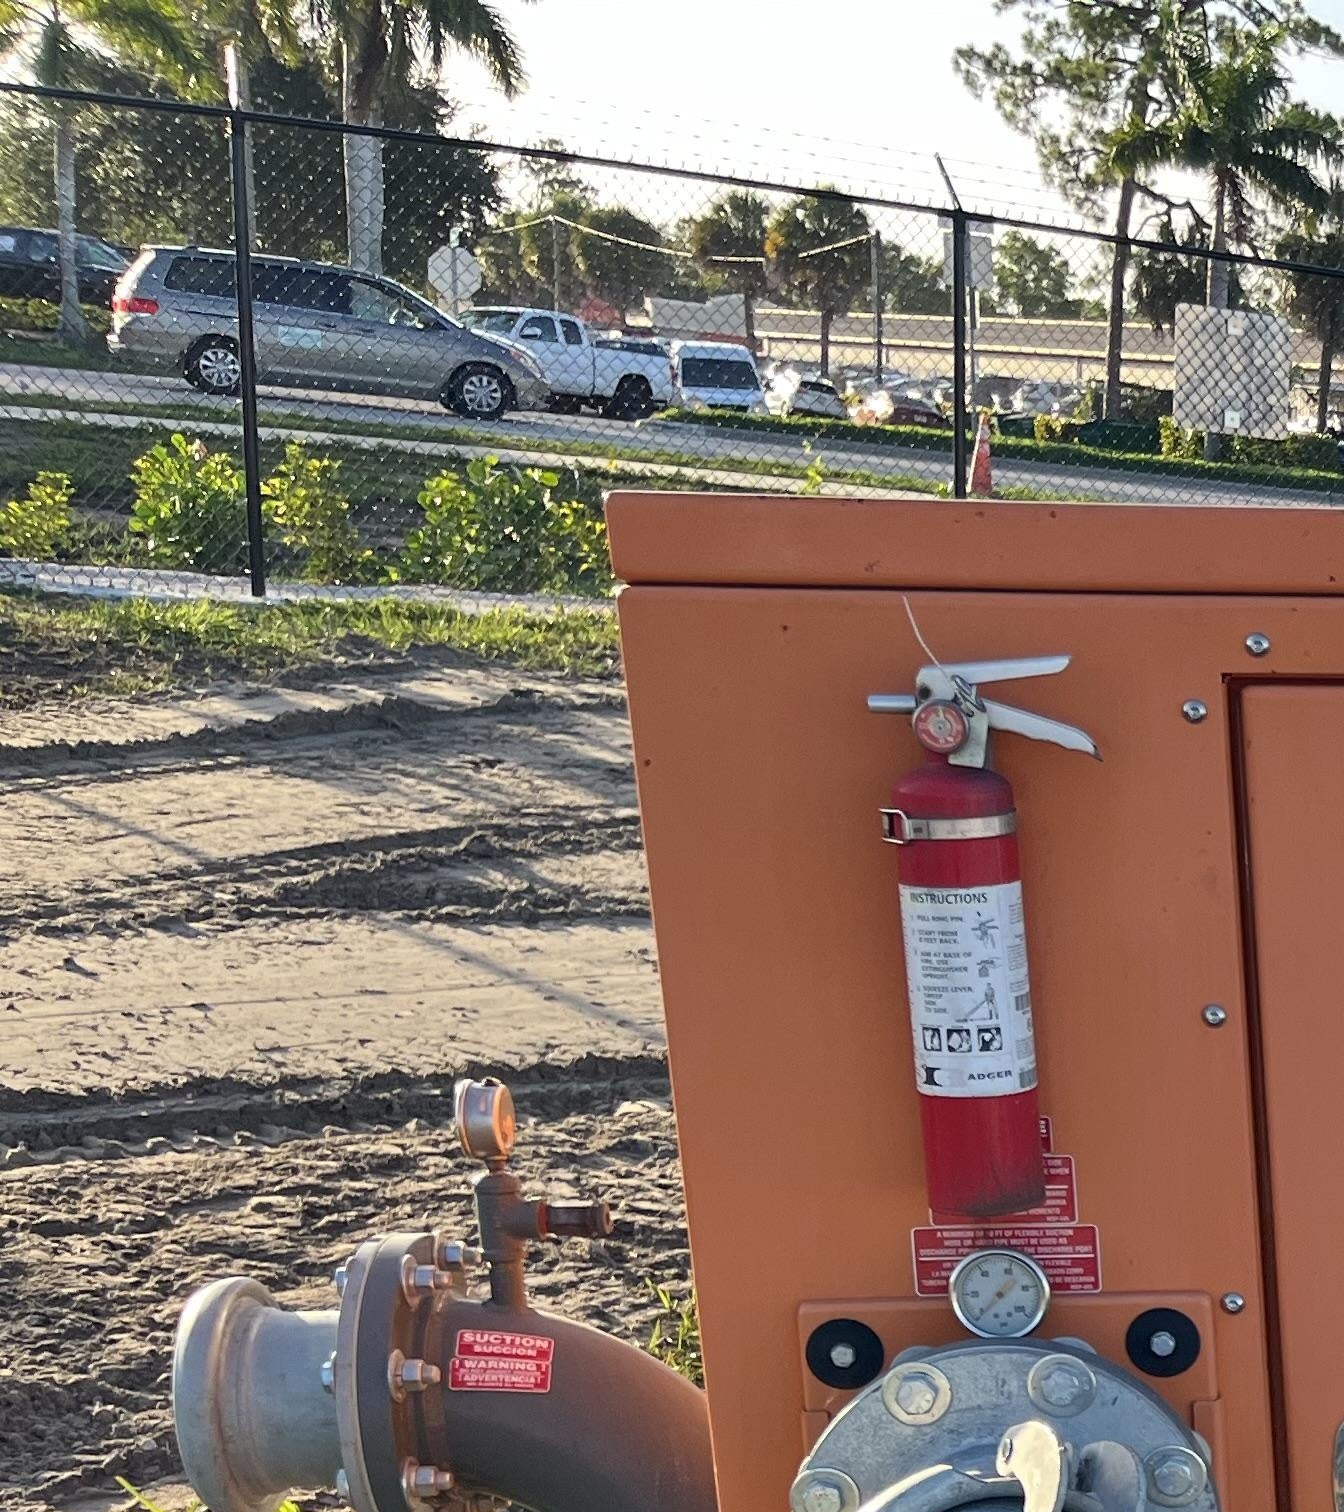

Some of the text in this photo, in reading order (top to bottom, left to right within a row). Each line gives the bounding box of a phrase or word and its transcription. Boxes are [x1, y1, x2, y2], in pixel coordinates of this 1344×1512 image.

[911, 893, 988, 904] INSTRUCTIONS
[463, 1333, 548, 1348] SUCTION
[474, 1345, 536, 1356] SUCCION
[464, 1360, 536, 1371] WARNING
